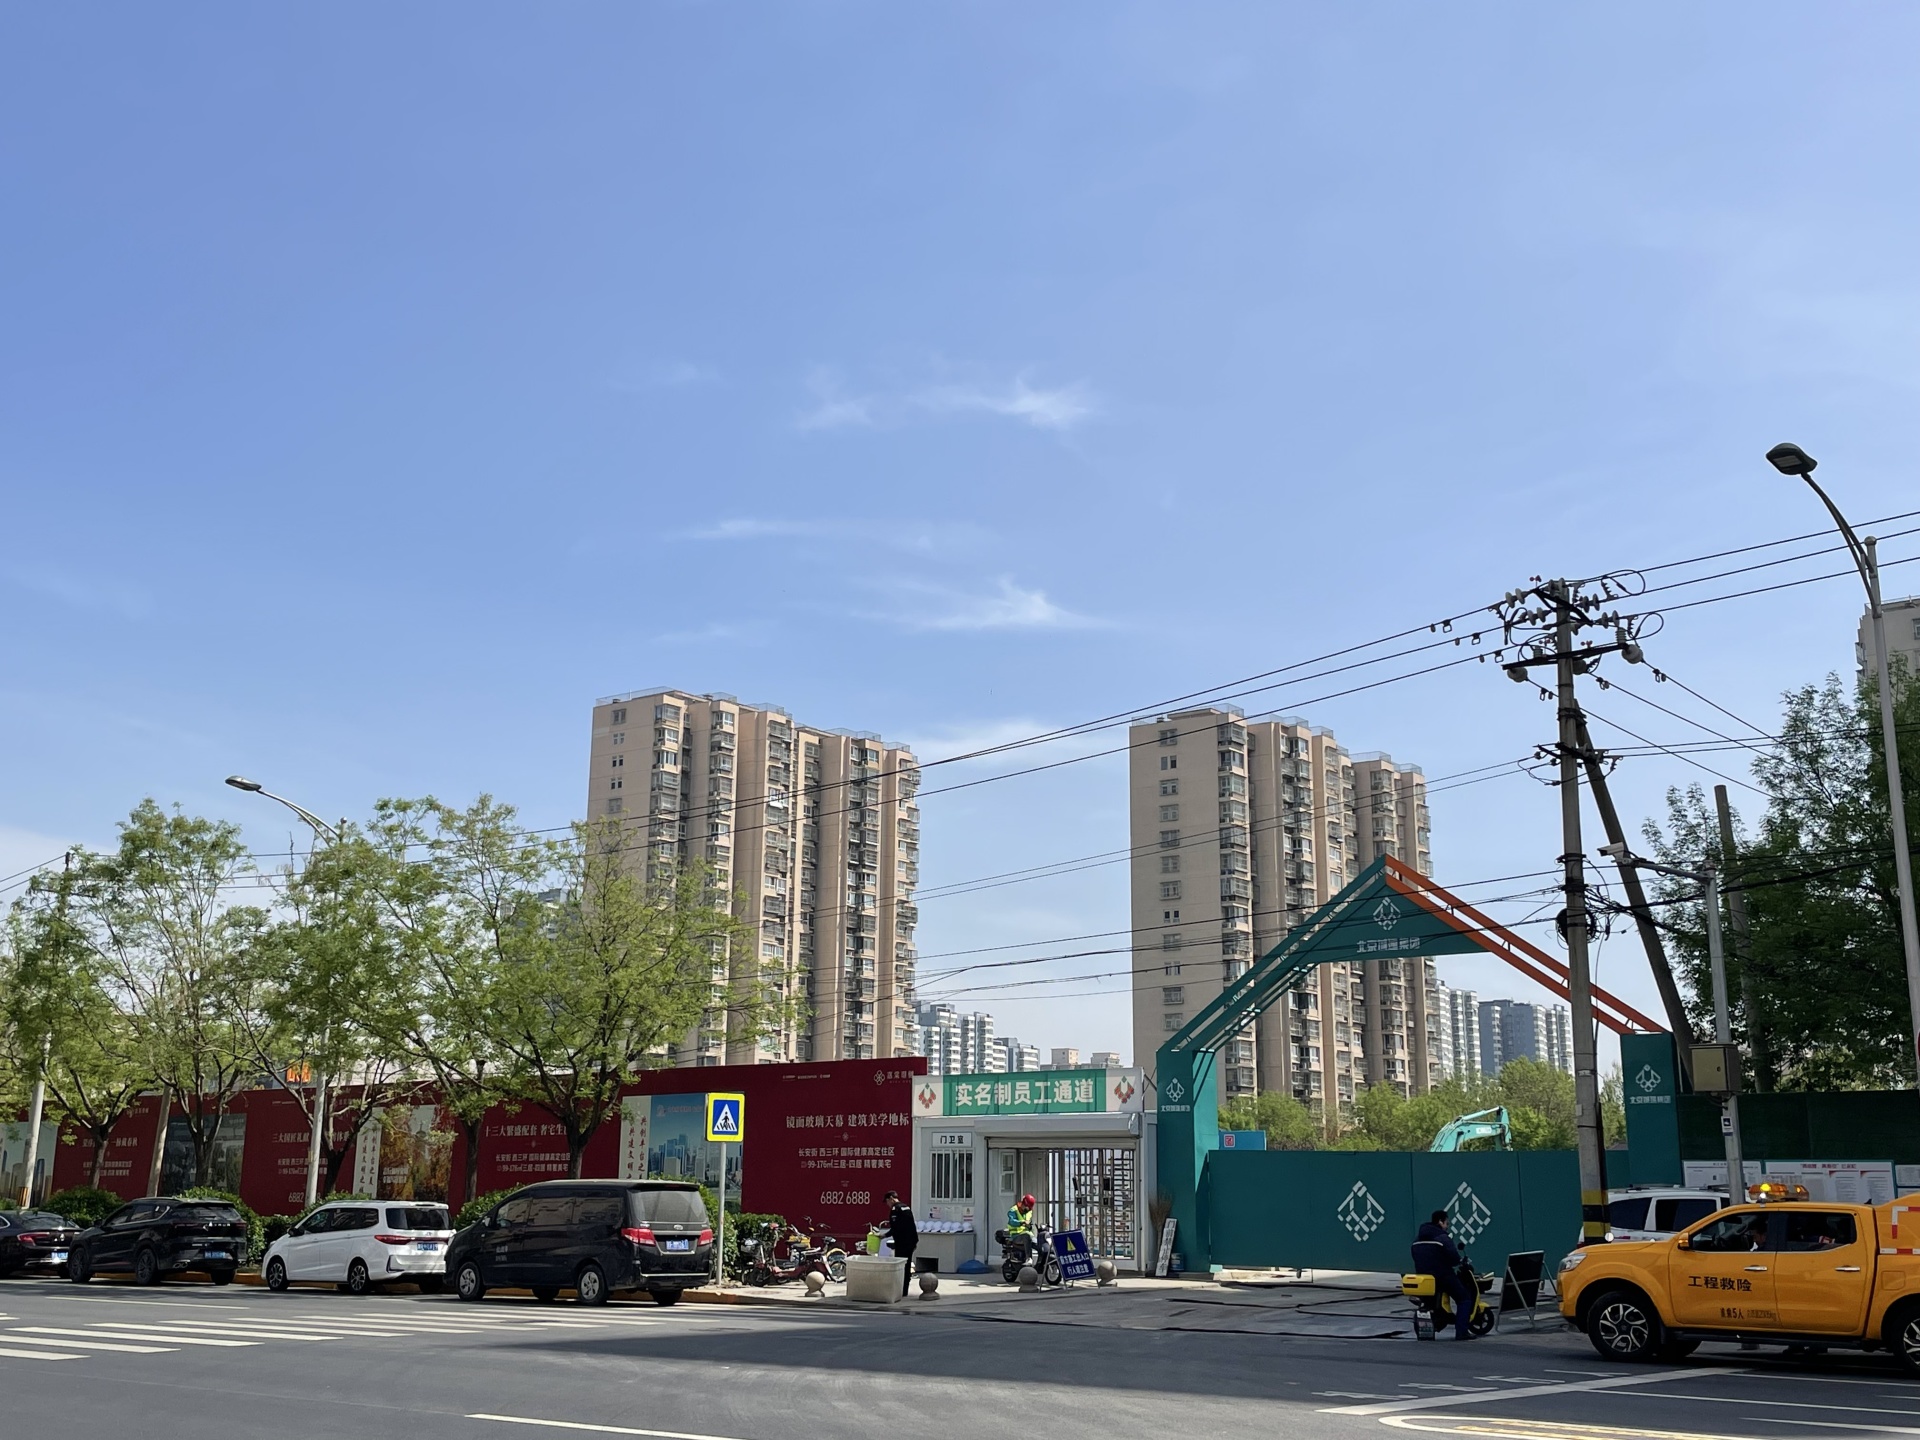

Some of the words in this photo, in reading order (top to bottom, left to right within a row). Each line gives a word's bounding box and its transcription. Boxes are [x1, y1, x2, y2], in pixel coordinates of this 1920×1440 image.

[955, 1078, 1094, 1107] 实名制员工通道
[786, 1114, 844, 1128] 镜面玻璃天幕
[847, 1112, 910, 1127] 建筑美学地标
[540, 1124, 567, 1136] 奢宅生
[940, 1135, 964, 1144] 门卫室
[798, 1147, 818, 1157] 长安街
[819, 1147, 839, 1157] 西三环
[820, 1191, 844, 1204] 6882
[845, 1191, 871, 1204] 6888
[1687, 1275, 1752, 1292] 工程救险
